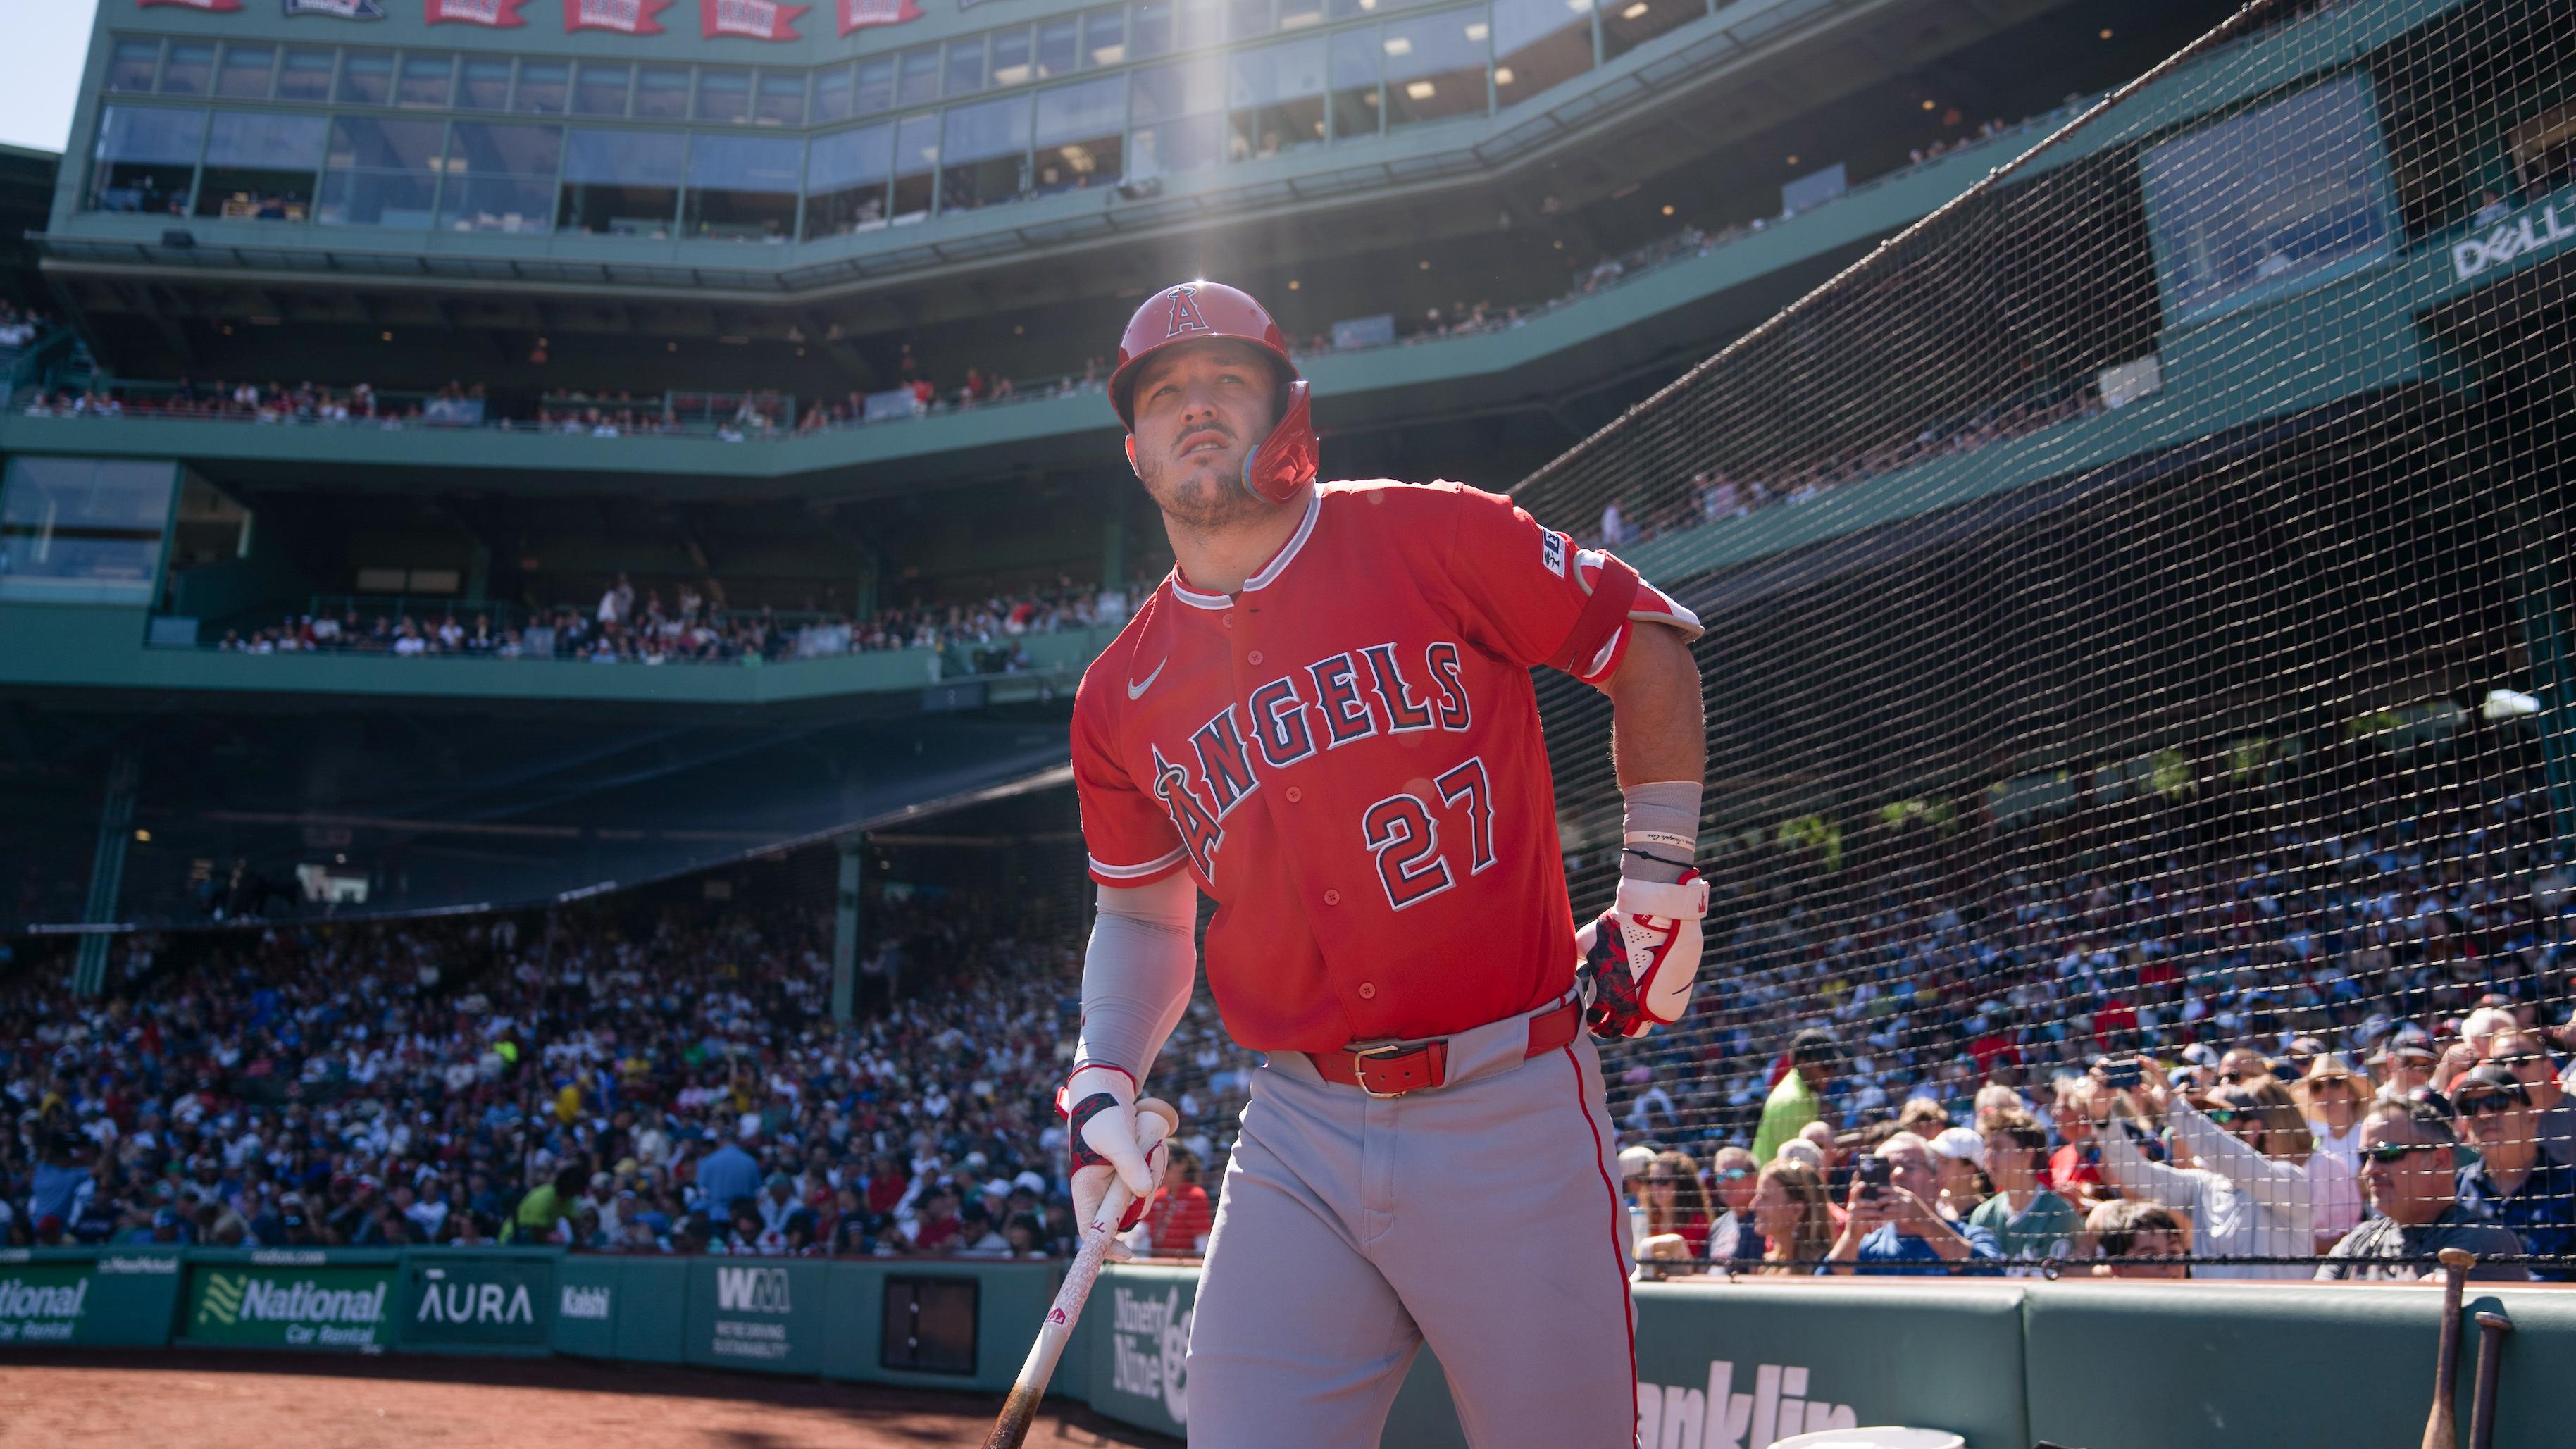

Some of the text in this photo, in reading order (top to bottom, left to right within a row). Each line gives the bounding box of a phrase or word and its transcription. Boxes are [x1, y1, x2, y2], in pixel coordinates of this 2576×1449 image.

[2451, 203, 2576, 280] DELL
[1166, 285, 1209, 338] A
[1152, 641, 1472, 888] ANGELS
[1362, 755, 1498, 911] 27
[240, 1279, 387, 1322] National
[716, 1267, 791, 1314] WM
[1114, 1288, 1164, 1344] Ninety
[22, 1319, 73, 1338] Rental
[285, 1324, 375, 1345] Car Rental
[1114, 1333, 1161, 1400] Nine
